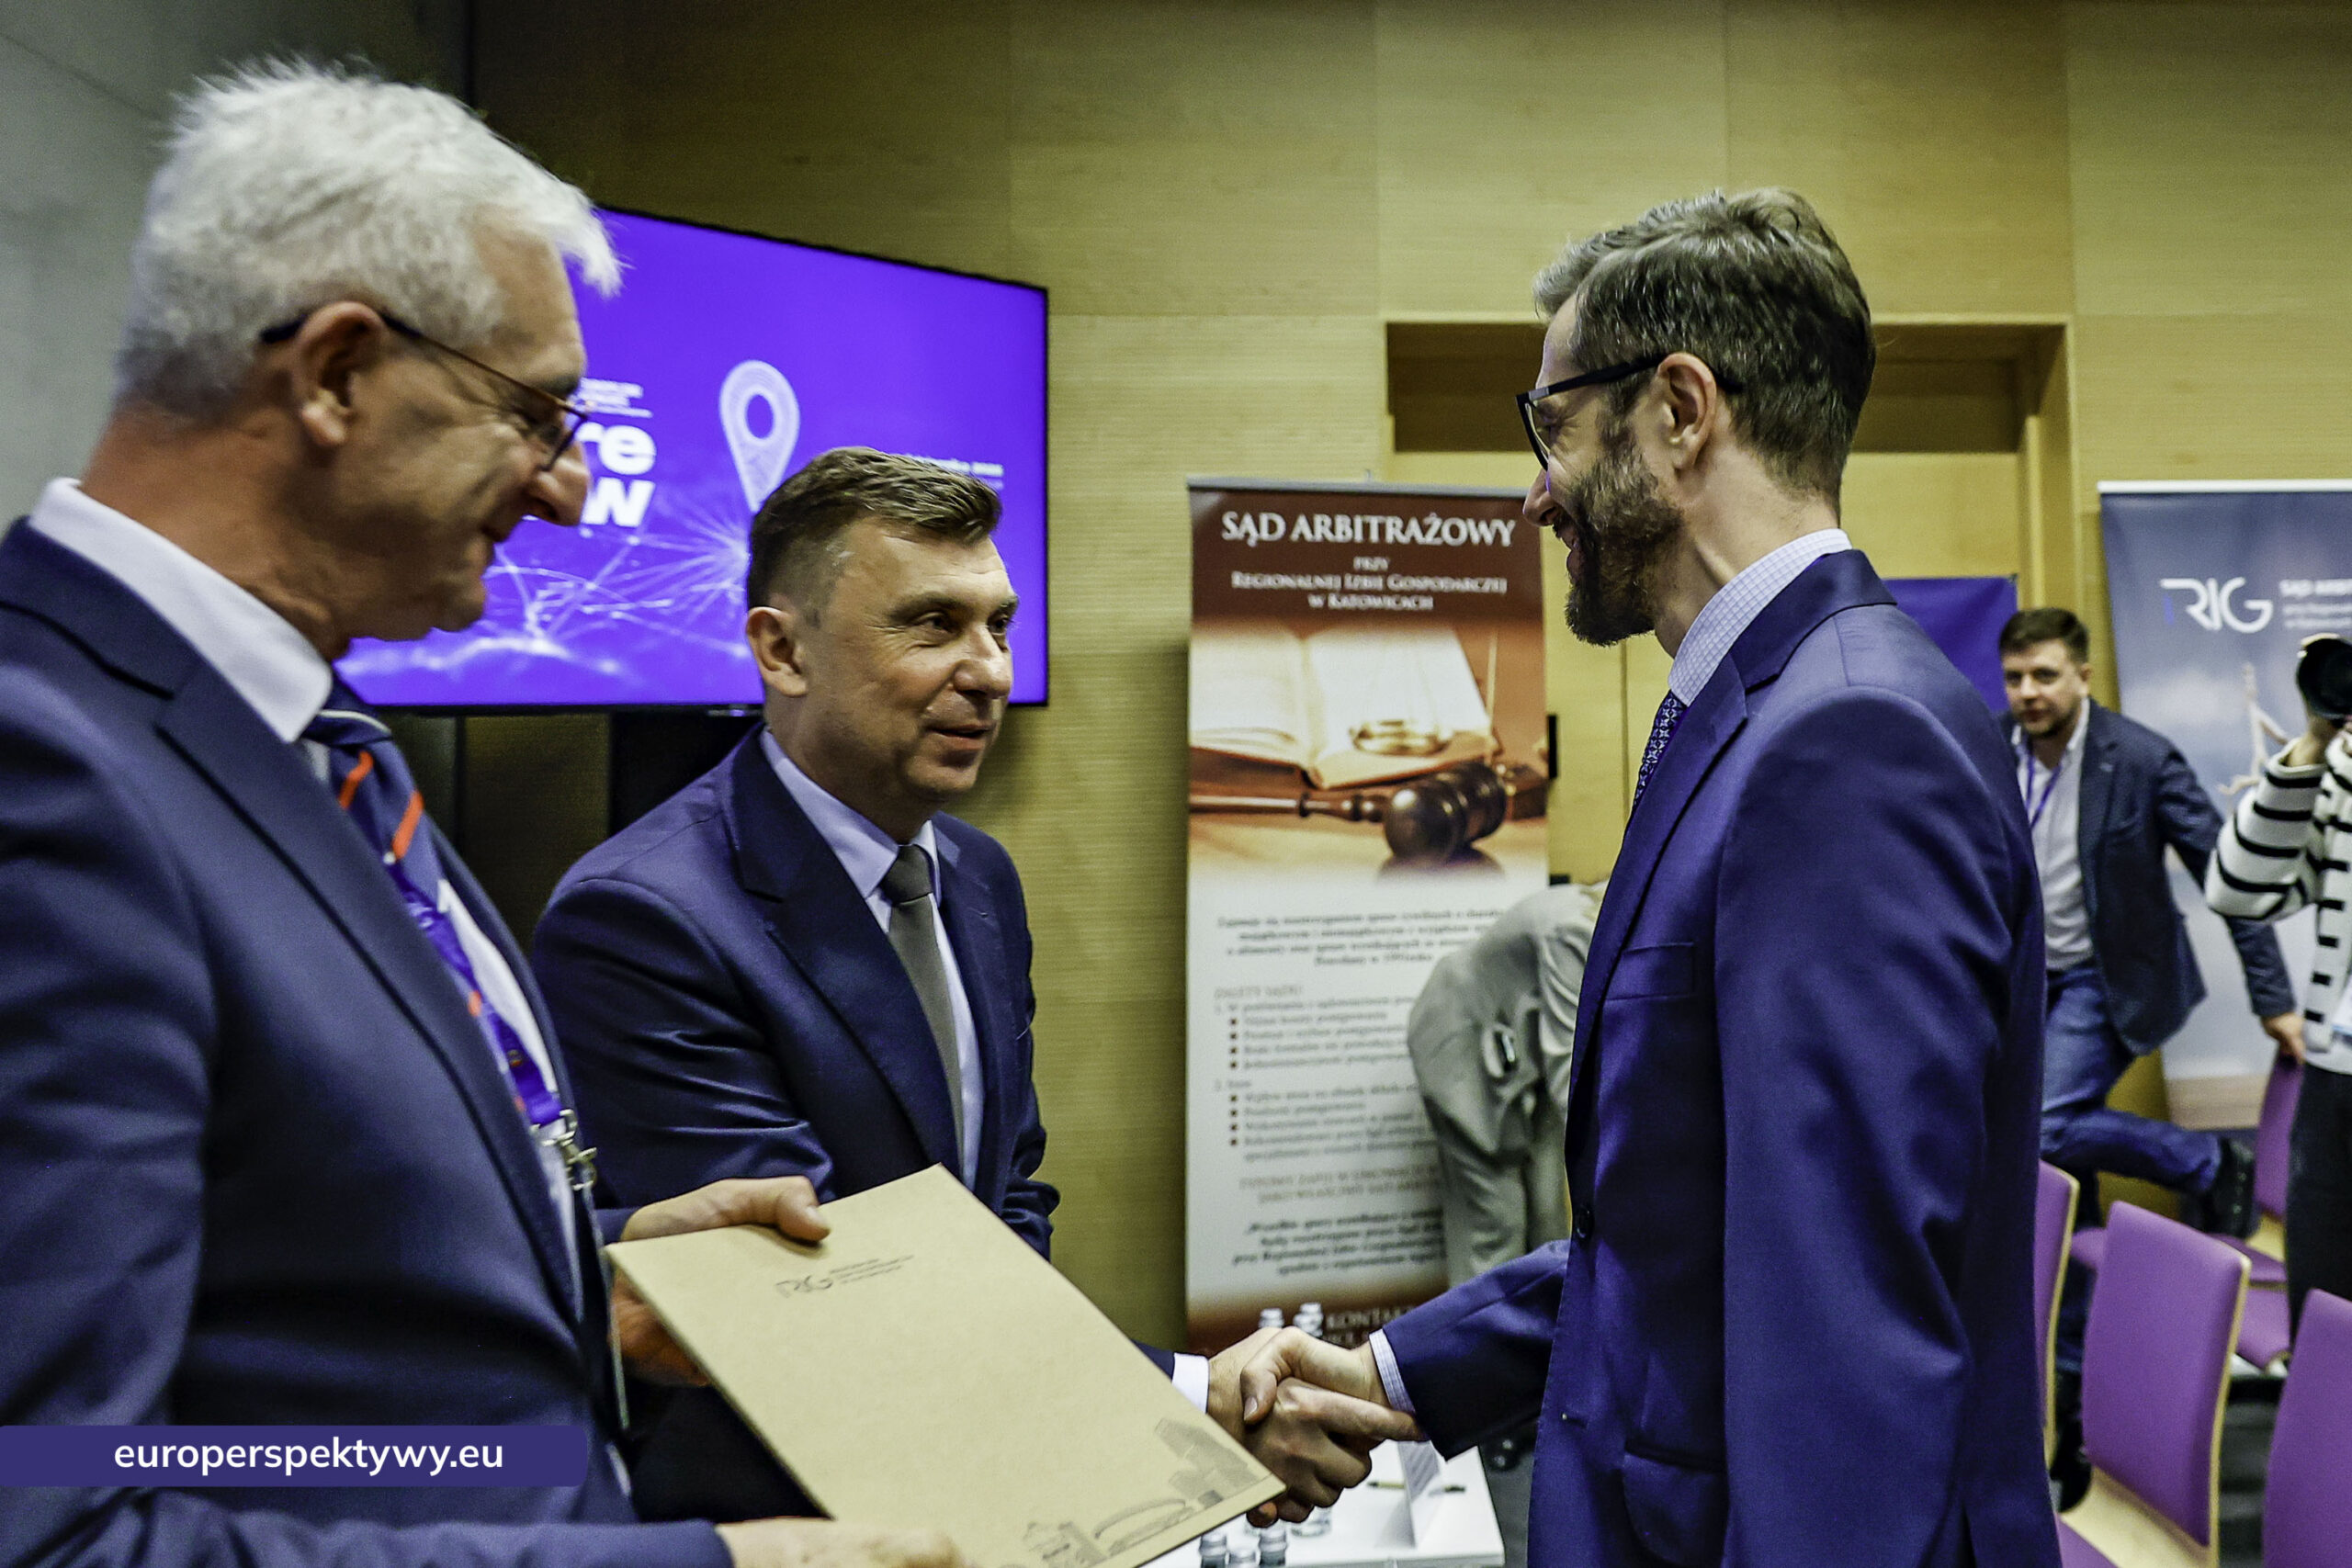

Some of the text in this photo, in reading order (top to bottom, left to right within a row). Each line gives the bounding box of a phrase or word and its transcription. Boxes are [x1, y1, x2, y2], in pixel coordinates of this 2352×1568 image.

[1222, 511, 1516, 547] SĄD ARBITRAŻOWY
[2159, 577, 2274, 634] RIG
